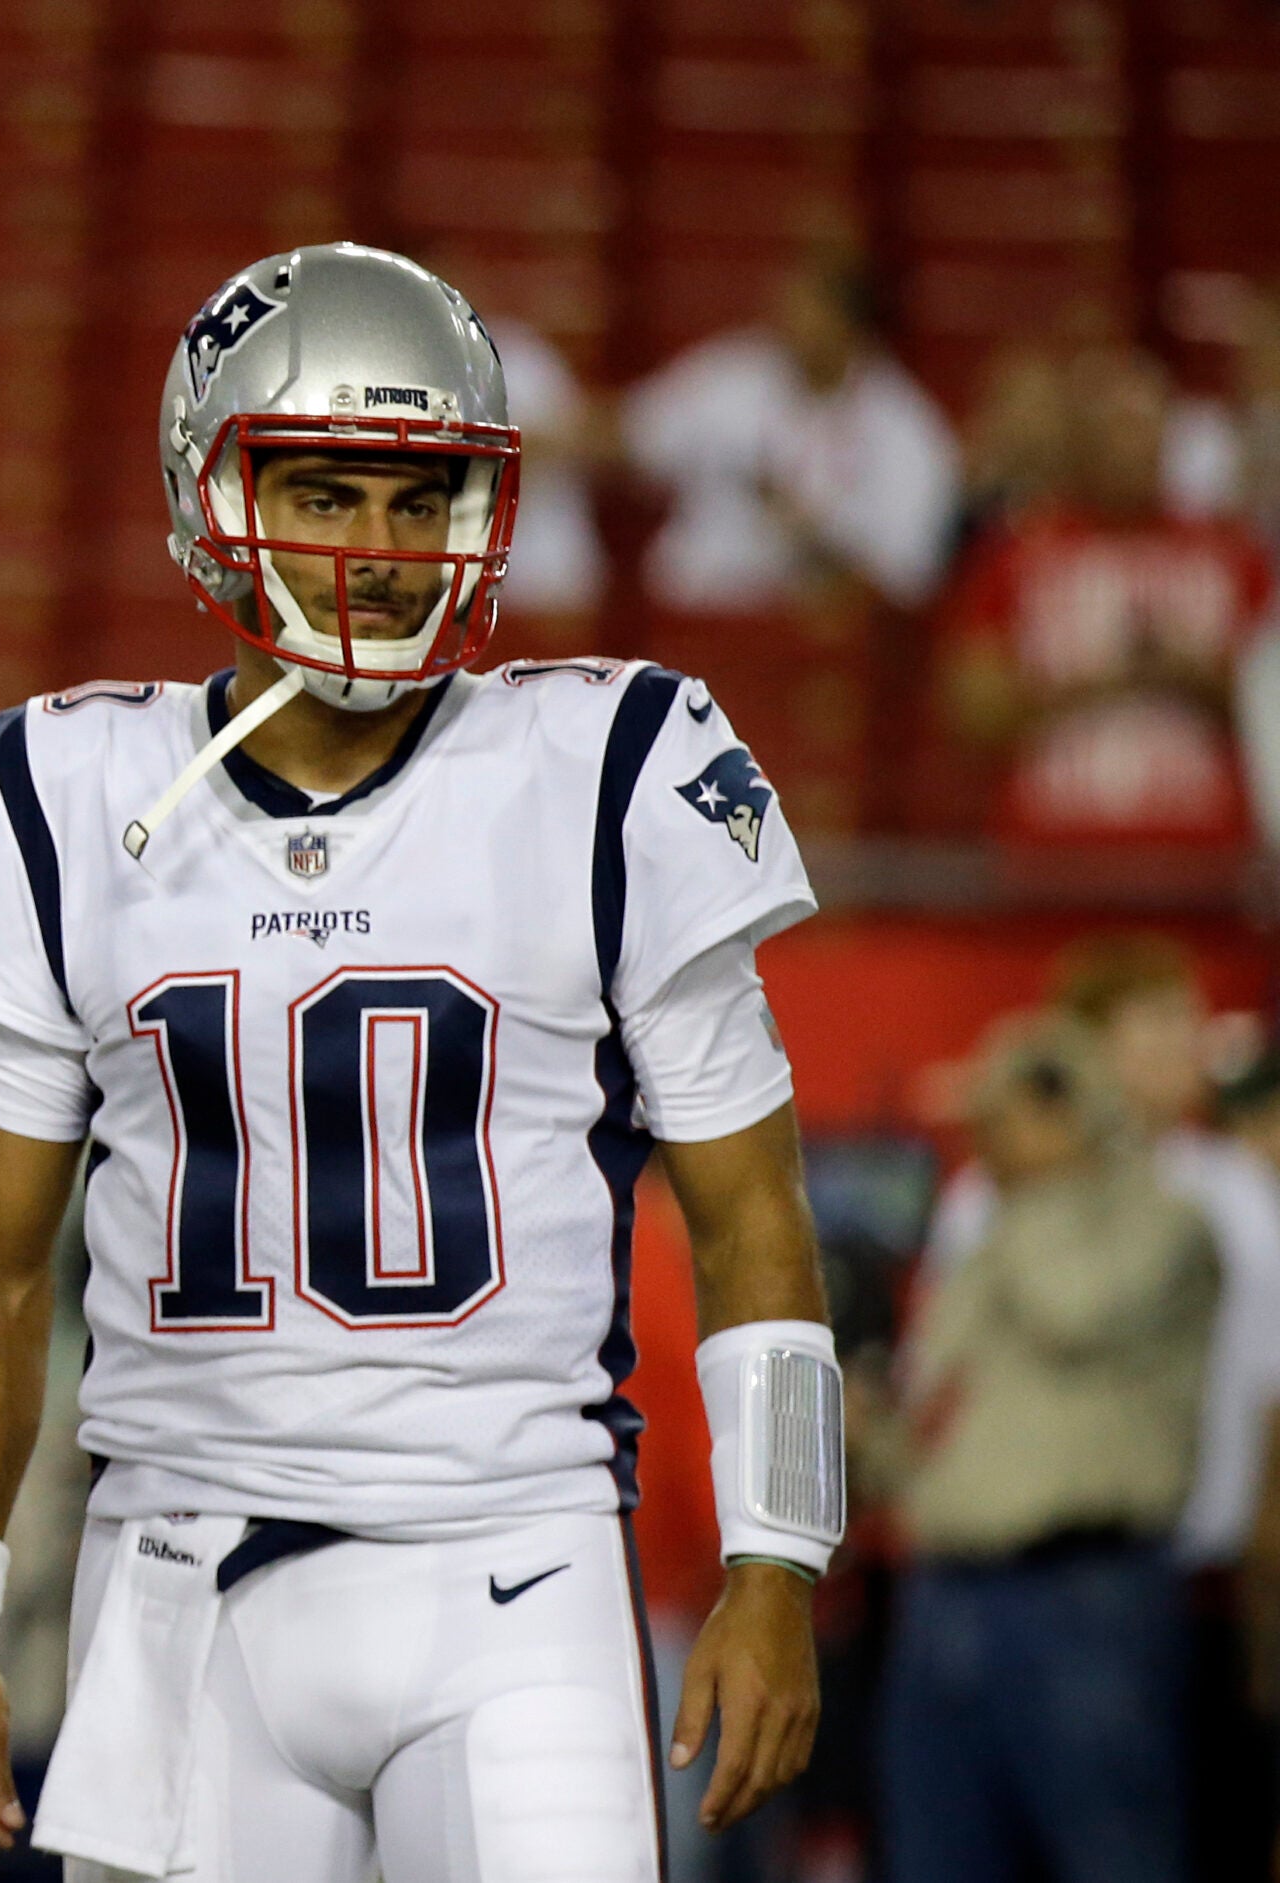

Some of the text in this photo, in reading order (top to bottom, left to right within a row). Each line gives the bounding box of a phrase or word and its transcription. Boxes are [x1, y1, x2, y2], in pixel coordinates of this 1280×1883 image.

[364, 386, 428, 411] PATRIOTS
[293, 851, 324, 873] NFL
[251, 910, 371, 941] PATRIOTS
[126, 965, 507, 1332] 10
